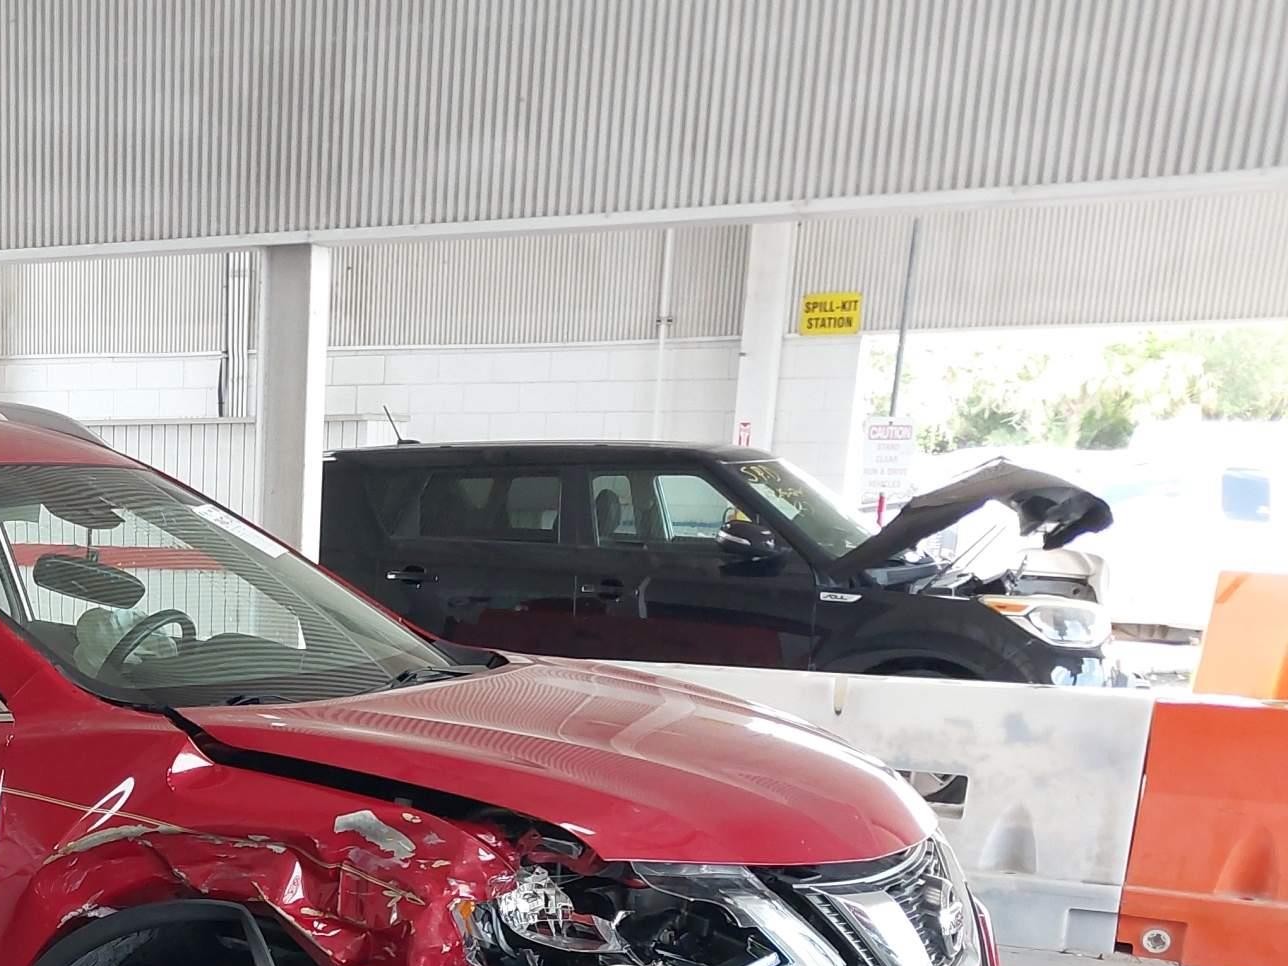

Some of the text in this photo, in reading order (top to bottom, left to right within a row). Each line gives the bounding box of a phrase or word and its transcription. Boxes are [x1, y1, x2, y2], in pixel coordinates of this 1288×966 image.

[804, 300, 859, 314] SPILL-KIT
[806, 316, 853, 329] STATION
[870, 426, 911, 439] CAUTION
